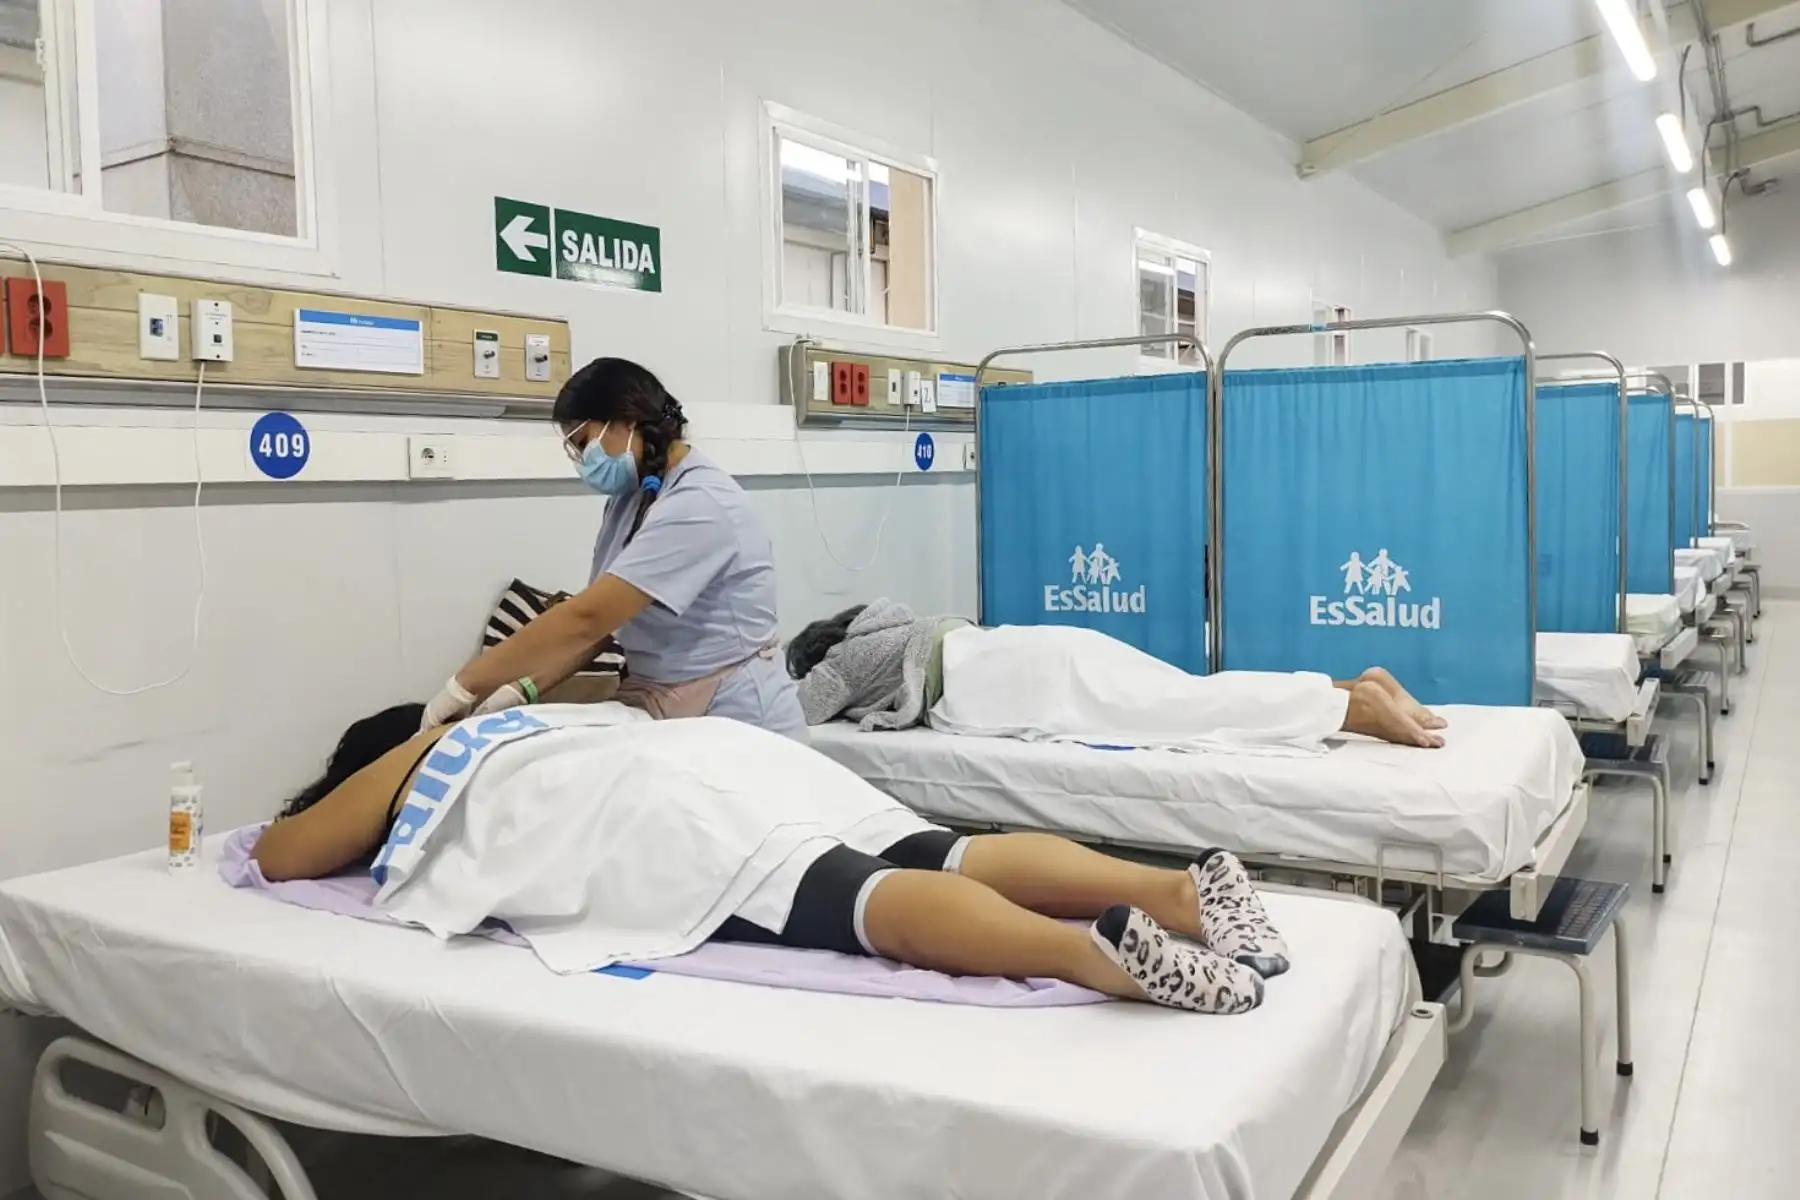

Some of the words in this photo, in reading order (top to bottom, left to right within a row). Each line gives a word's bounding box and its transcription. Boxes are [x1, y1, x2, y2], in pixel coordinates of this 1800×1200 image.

[562, 229, 656, 274] SALIDA
[258, 431, 306, 459] 409
[917, 443, 933, 460] 410
[1043, 582, 1147, 614] EsSalud
[1309, 594, 1441, 631] EsSalud
